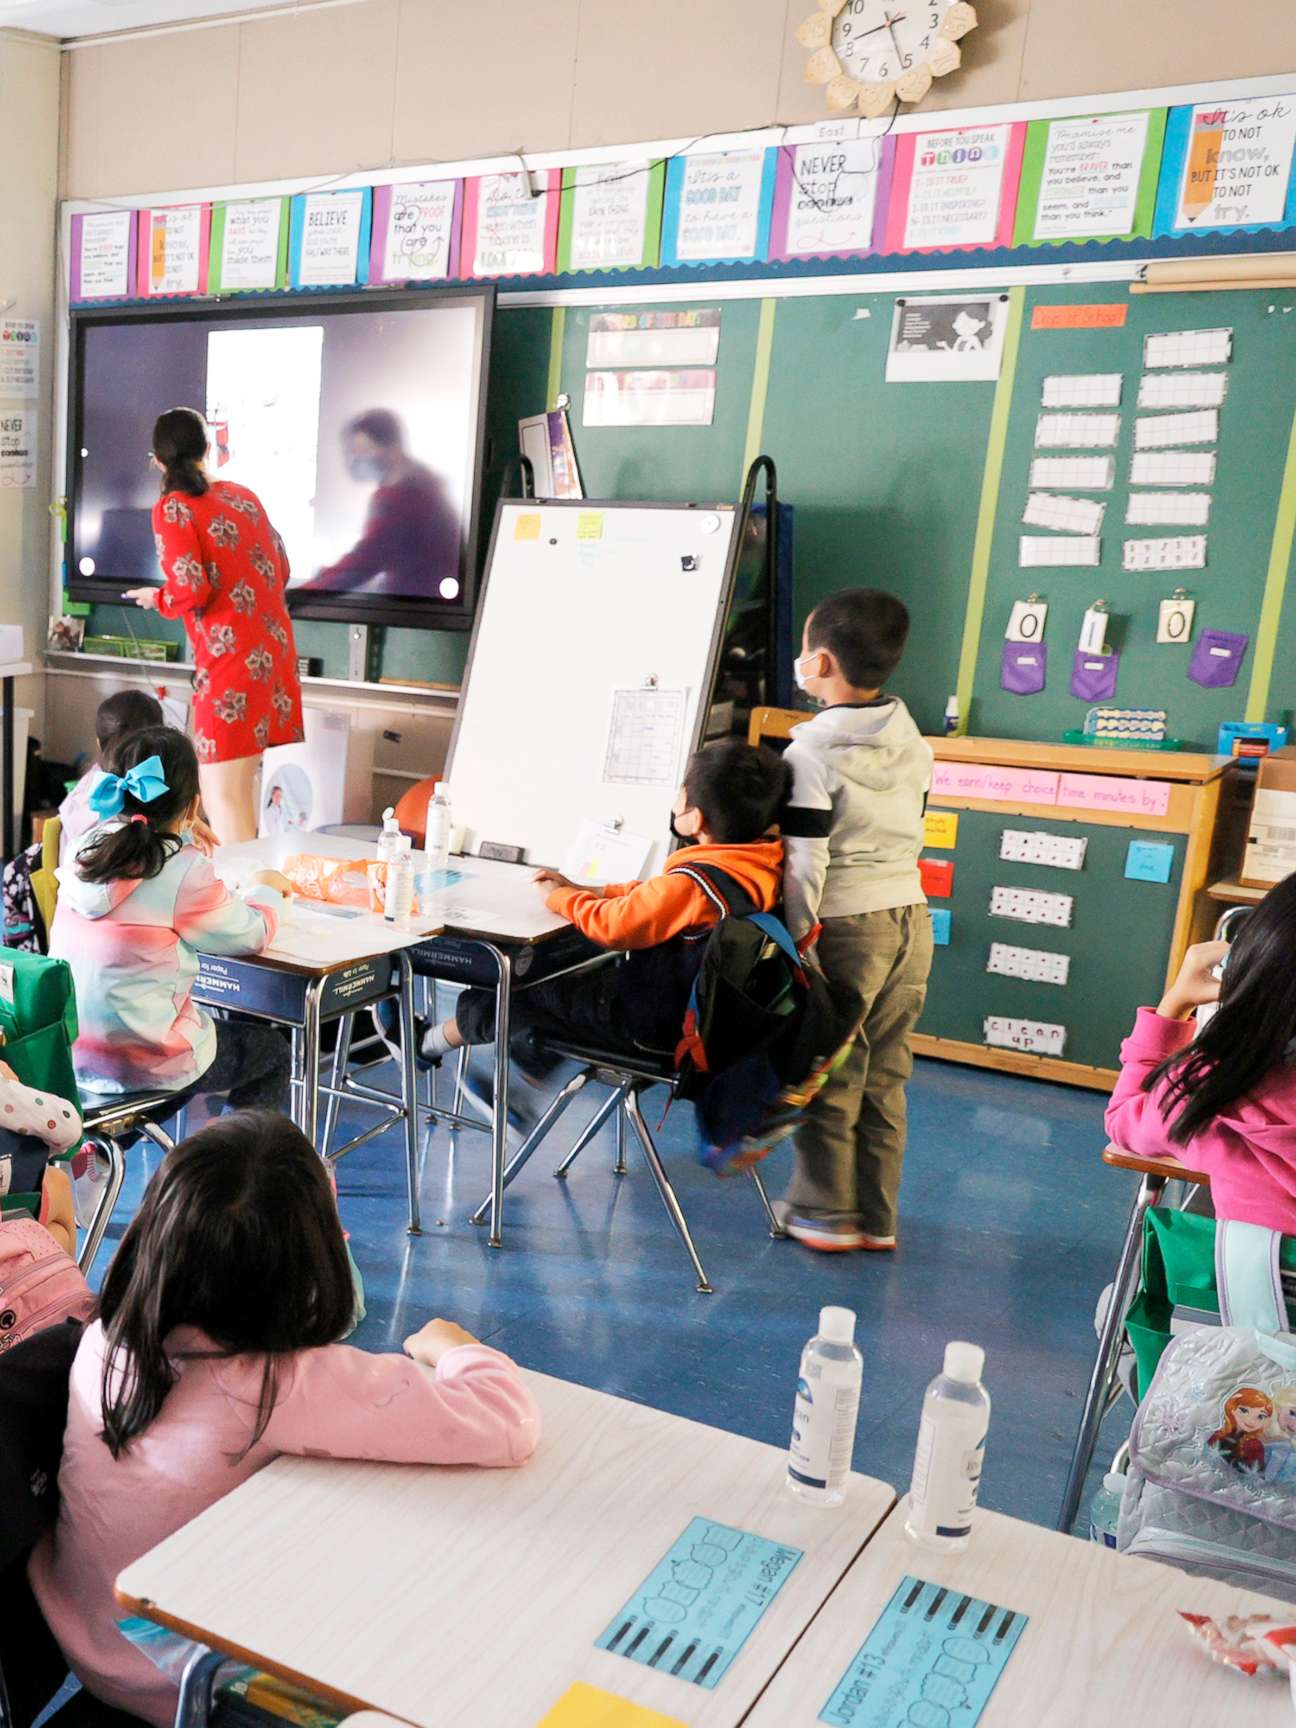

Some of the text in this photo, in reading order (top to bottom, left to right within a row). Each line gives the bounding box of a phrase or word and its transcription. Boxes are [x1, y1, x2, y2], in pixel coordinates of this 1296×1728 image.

[928, 13, 939, 29] 3
[842, 23, 852, 37] 9
[920, 34, 930, 50] 4
[859, 58, 870, 73] 7
[903, 53, 913, 69] 5
[878, 63, 888, 77] 6
[1223, 126, 1262, 142] TO NOT
[1206, 147, 1270, 165] know,
[801, 153, 847, 176] NEVER
[1103, 172, 1121, 181] and
[1191, 164, 1280, 183] BUT IT'S NOT OK
[1213, 184, 1252, 199] TO NOT
[1072, 200, 1089, 209] and
[1214, 203, 1251, 222] try.
[308, 210, 349, 226] BELIEVE
[421, 223, 442, 235] you
[935, 771, 951, 787] We
[1023, 776, 1055, 795] choice
[1063, 786, 1086, 799] time
[1093, 790, 1135, 804] minutes
[410, 947, 473, 965] HAMMERMILL
[210, 964, 228, 976] Paper
[333, 974, 375, 991] HAMMERMILL
[1011, 1034, 1035, 1048] up
[744, 1547, 797, 1607] Megan #17
[828, 1653, 886, 1724] Jordan #13
